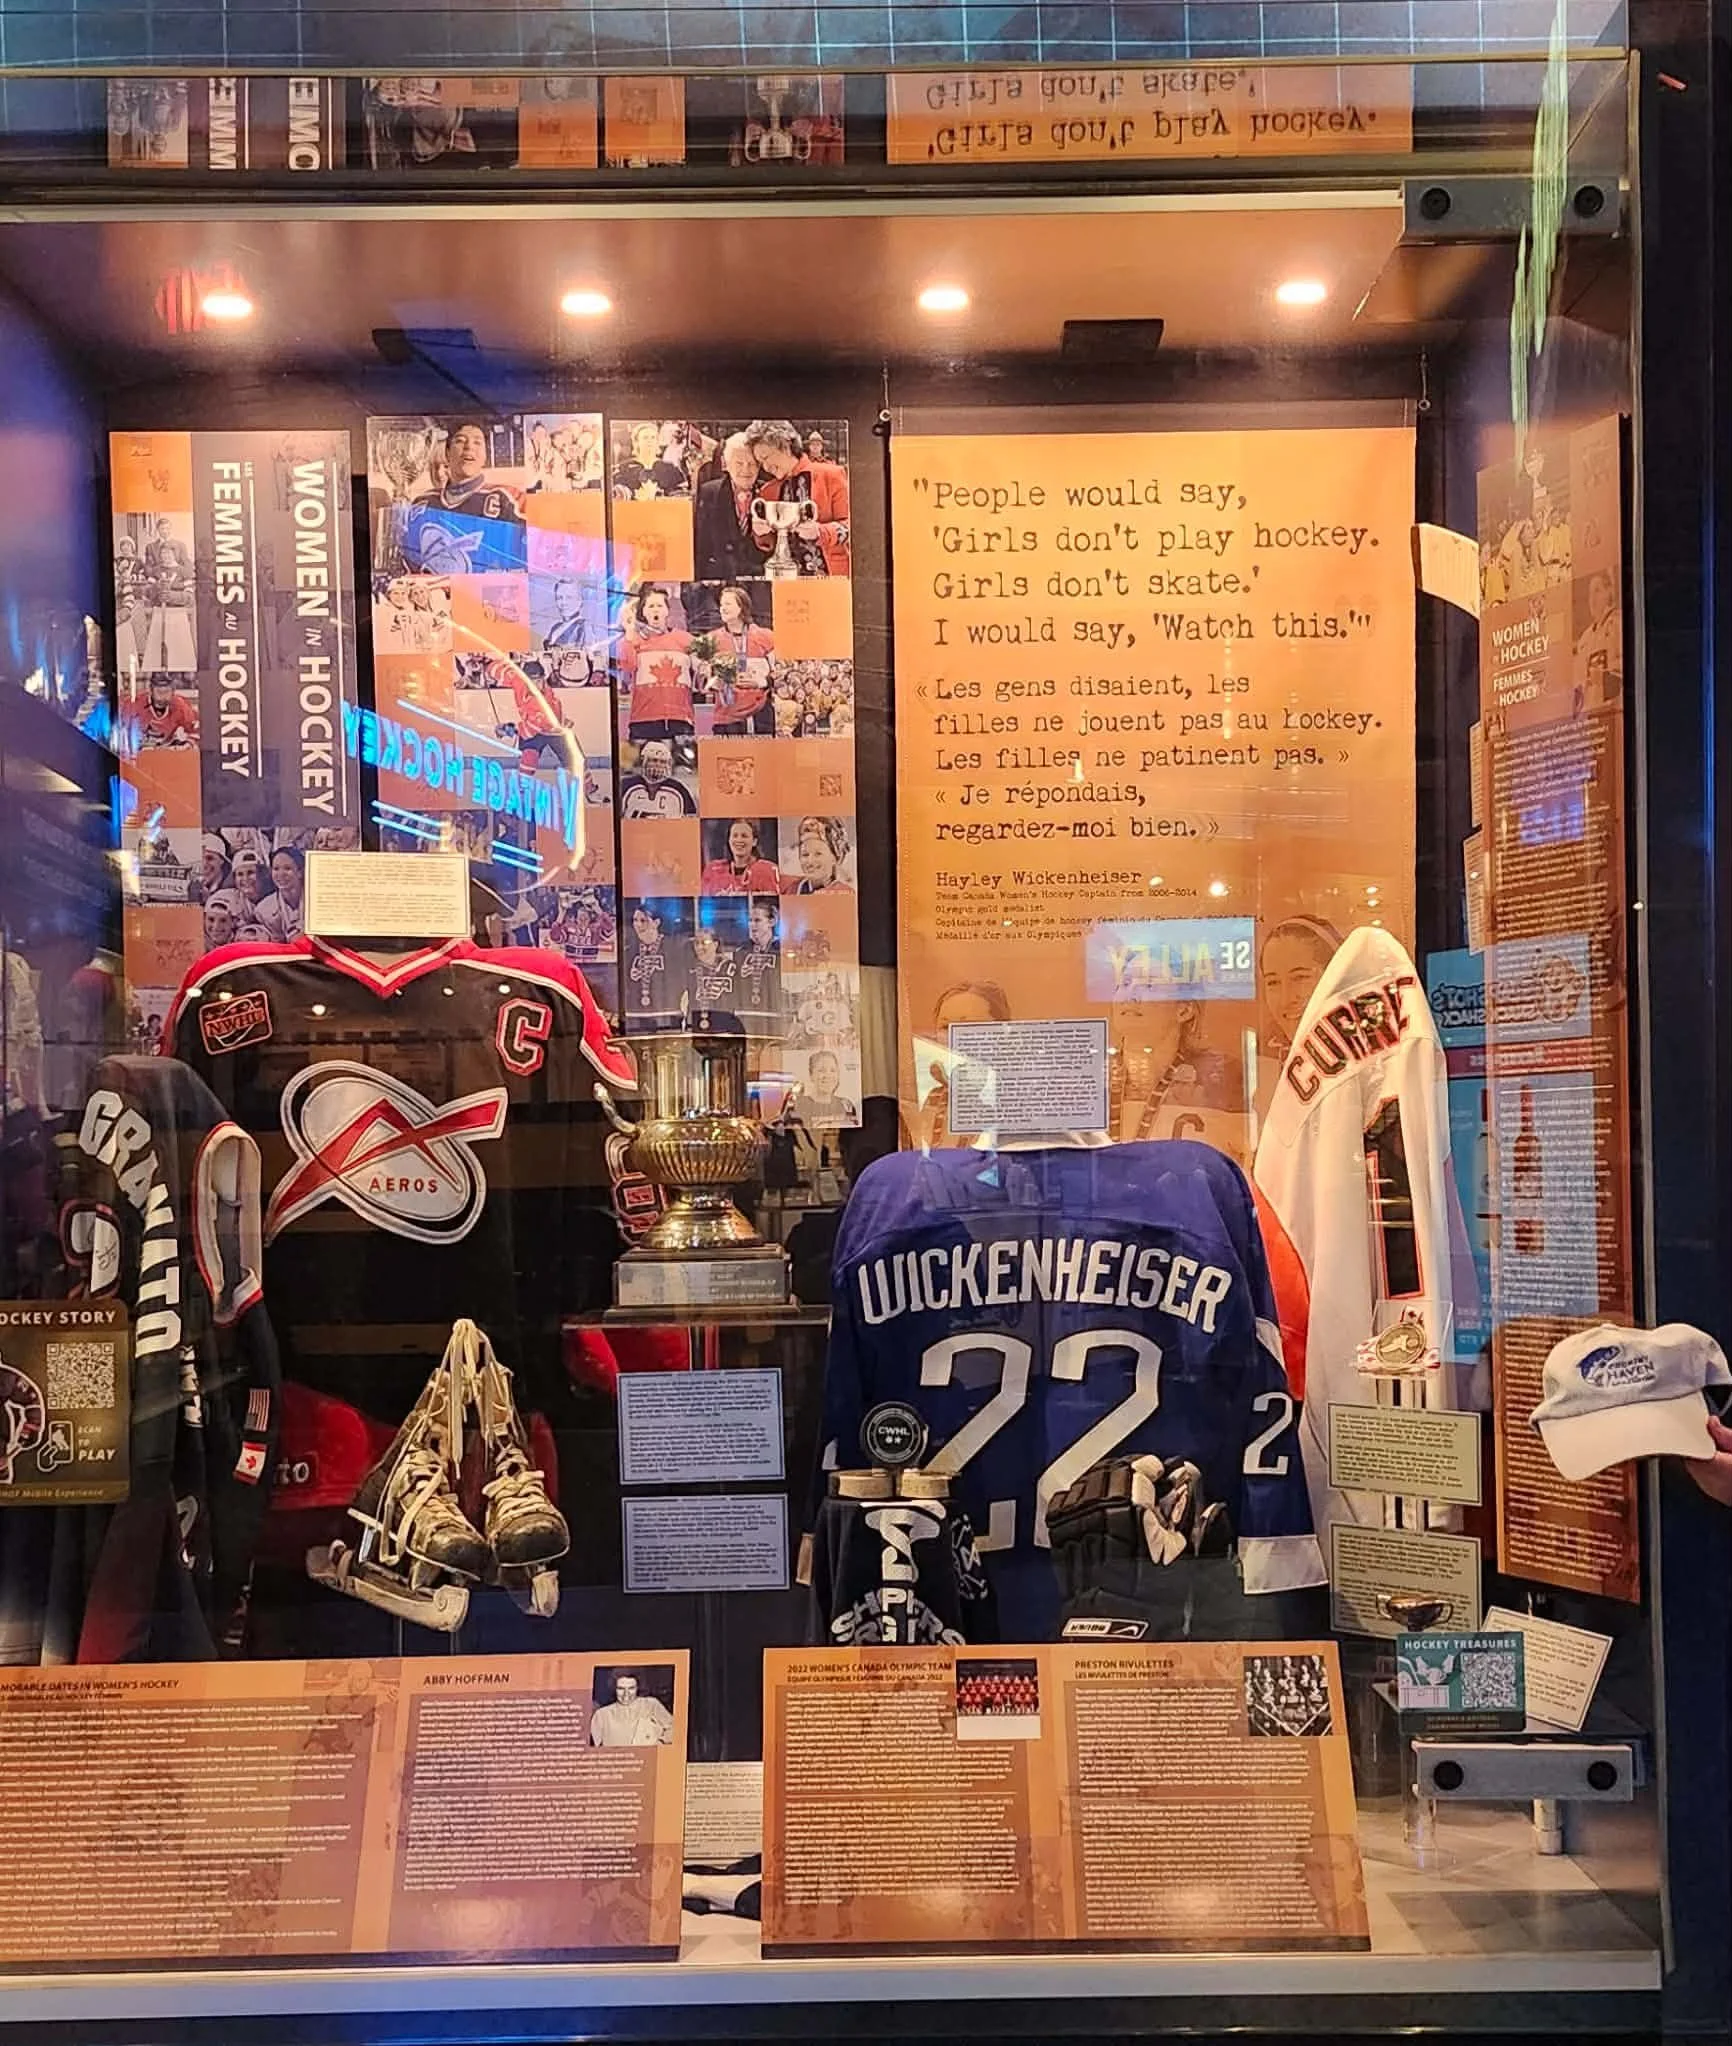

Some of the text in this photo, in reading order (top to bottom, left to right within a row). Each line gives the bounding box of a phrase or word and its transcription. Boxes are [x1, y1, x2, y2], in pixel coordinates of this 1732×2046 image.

[1065, 480, 1162, 507] would
[1180, 481, 1247, 511] say,
[1056, 523, 1139, 551] don't
[1157, 525, 1234, 557] play
[1253, 521, 1380, 555] hockey.
[933, 571, 1029, 599] Girls
[1046, 568, 1130, 596] don't
[212, 462, 250, 777] FEMMES AU HOCKEY
[934, 618, 949, 645] I
[967, 616, 1055, 644] would
[1073, 619, 1136, 648] say,
[1492, 617, 1540, 648] WOMEN
[294, 461, 335, 815] WOMEN IN HOCKEY
[1501, 634, 1549, 665] HOCKEY
[936, 678, 982, 700] Les
[995, 680, 1056, 702] gens
[1070, 675, 1193, 700] disaient,
[1206, 674, 1250, 695] les
[1493, 669, 1533, 692] FEMMES
[1499, 684, 1540, 707] HOCKEY
[934, 713, 1019, 735] filles
[1033, 716, 1064, 733] ne
[1078, 710, 1166, 737] jouent
[1180, 712, 1224, 735] pas
[1237, 713, 1268, 729] au
[936, 749, 982, 771] Les
[995, 748, 1081, 770] filles
[1095, 749, 1126, 769] ne
[1139, 745, 1260, 772] patinent
[1273, 747, 1325, 771] pas.
[960, 783, 990, 806] Je
[1005, 781, 1147, 808] répondais,
[936, 819, 1117, 846] regardez-moi
[1131, 816, 1198, 838] bien.
[935, 869, 1141, 890] Hayley Wickenheiser
[497, 998, 552, 1076] C
[369, 1176, 439, 1194] AEROS
[859, 1239, 1232, 1333] WICKENHEISER
[0, 1311, 116, 1325] OCKEY STORY
[1607, 1361, 1655, 1379] HAVEN
[878, 1425, 911, 1436] CWHL
[920, 1329, 1163, 1552] 22
[78, 1450, 116, 1461] PLAY
[1404, 1639, 1517, 1649] HOCKEY TREASURES
[809, 1663, 849, 1673] WOMEN'S
[852, 1663, 889, 1672] CANADA
[890, 1662, 927, 1671] OLYMPIC
[928, 1662, 952, 1671] TEAM
[1074, 1660, 1174, 1669] PRESTON RIVULETTES
[0, 1682, 46, 1692] MORABLE
[50, 1681, 79, 1691] DATES
[93, 1680, 138, 1690] WOMEN'S
[140, 1679, 180, 1689] HOCKEY
[423, 1673, 510, 1686] ABBY HOFFMAN
